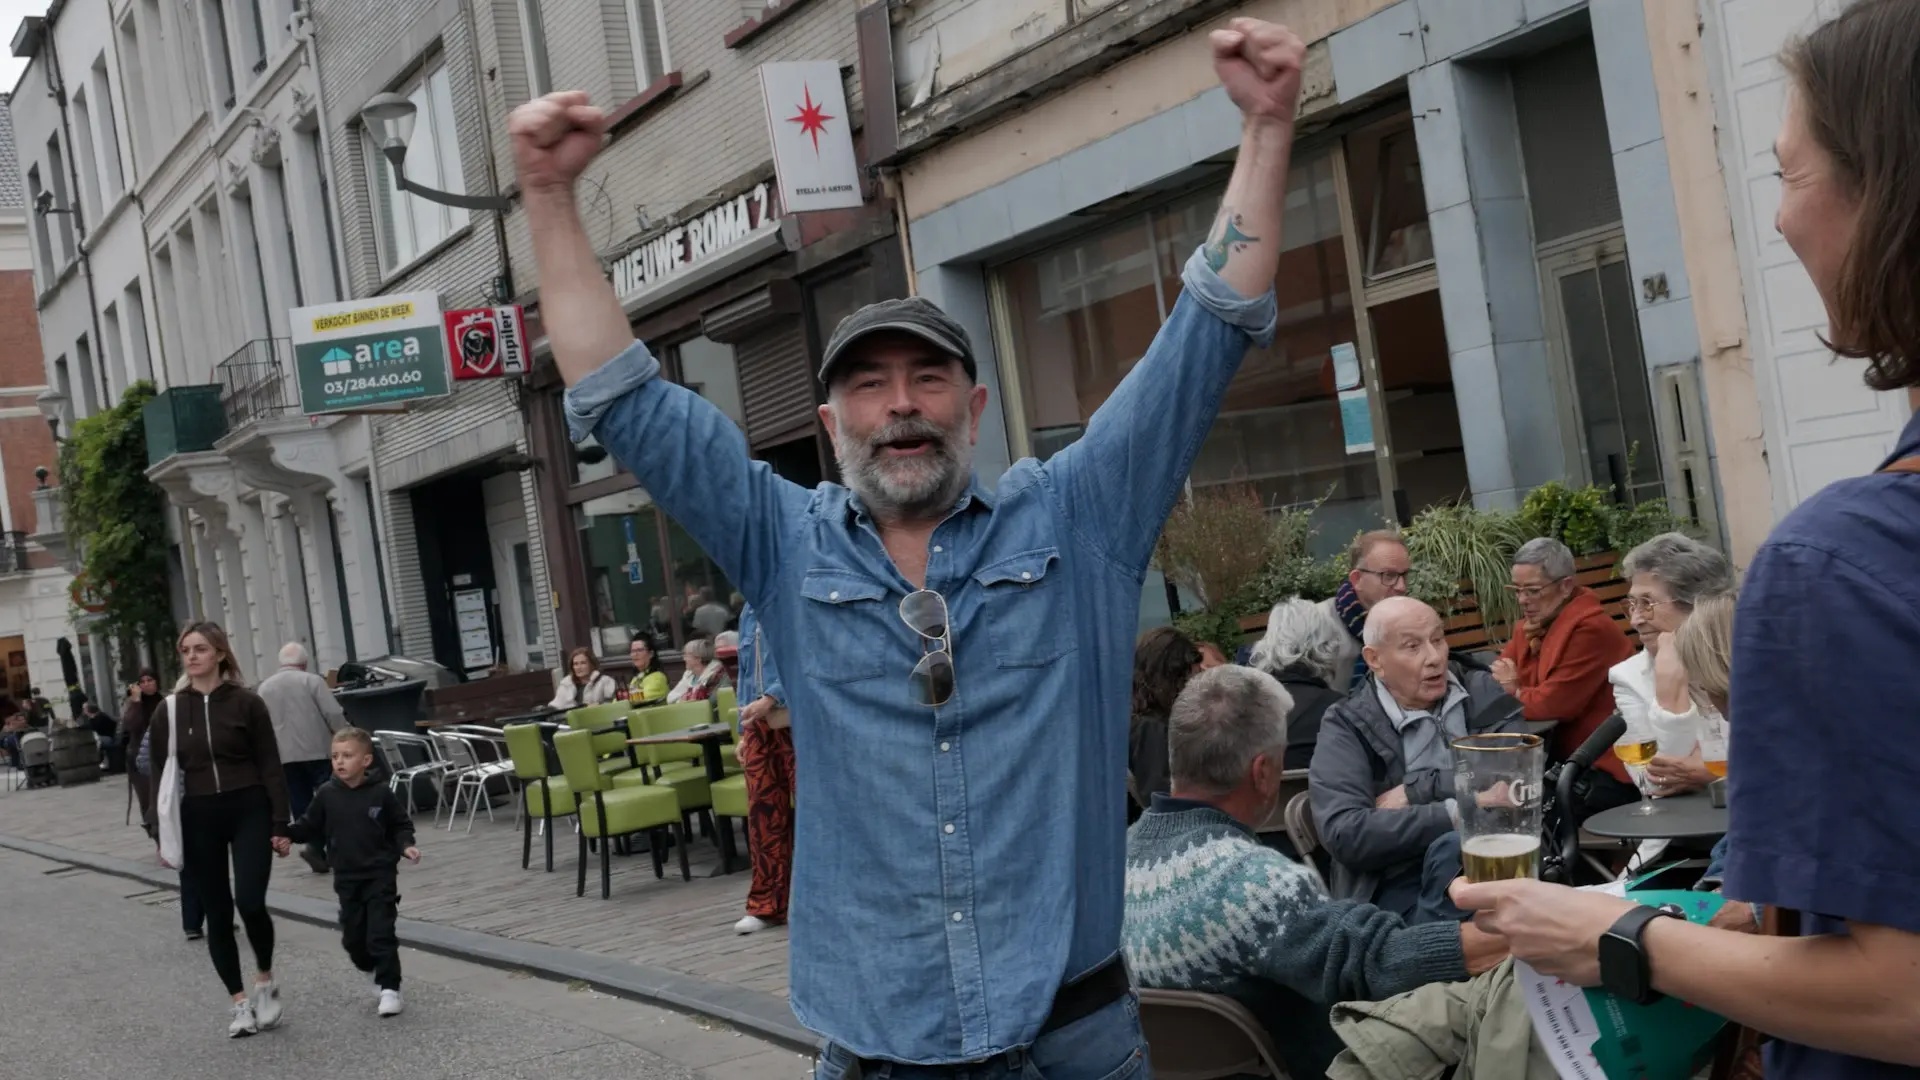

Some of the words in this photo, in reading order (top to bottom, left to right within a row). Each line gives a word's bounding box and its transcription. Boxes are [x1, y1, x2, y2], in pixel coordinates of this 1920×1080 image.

[828, 184, 853, 193] ARTOIS
[613, 226, 684, 298] NIEUWE
[688, 194, 751, 262] ROMA
[1641, 270, 1671, 303] 34
[315, 314, 351, 330] VERKOCHT
[353, 309, 379, 323] BINNEN
[379, 307, 390, 318] DE
[391, 303, 411, 315] WEEK
[355, 336, 420, 364] area
[500, 310, 521, 368] Jupiler
[323, 370, 422, 396] 03/284.60.60
